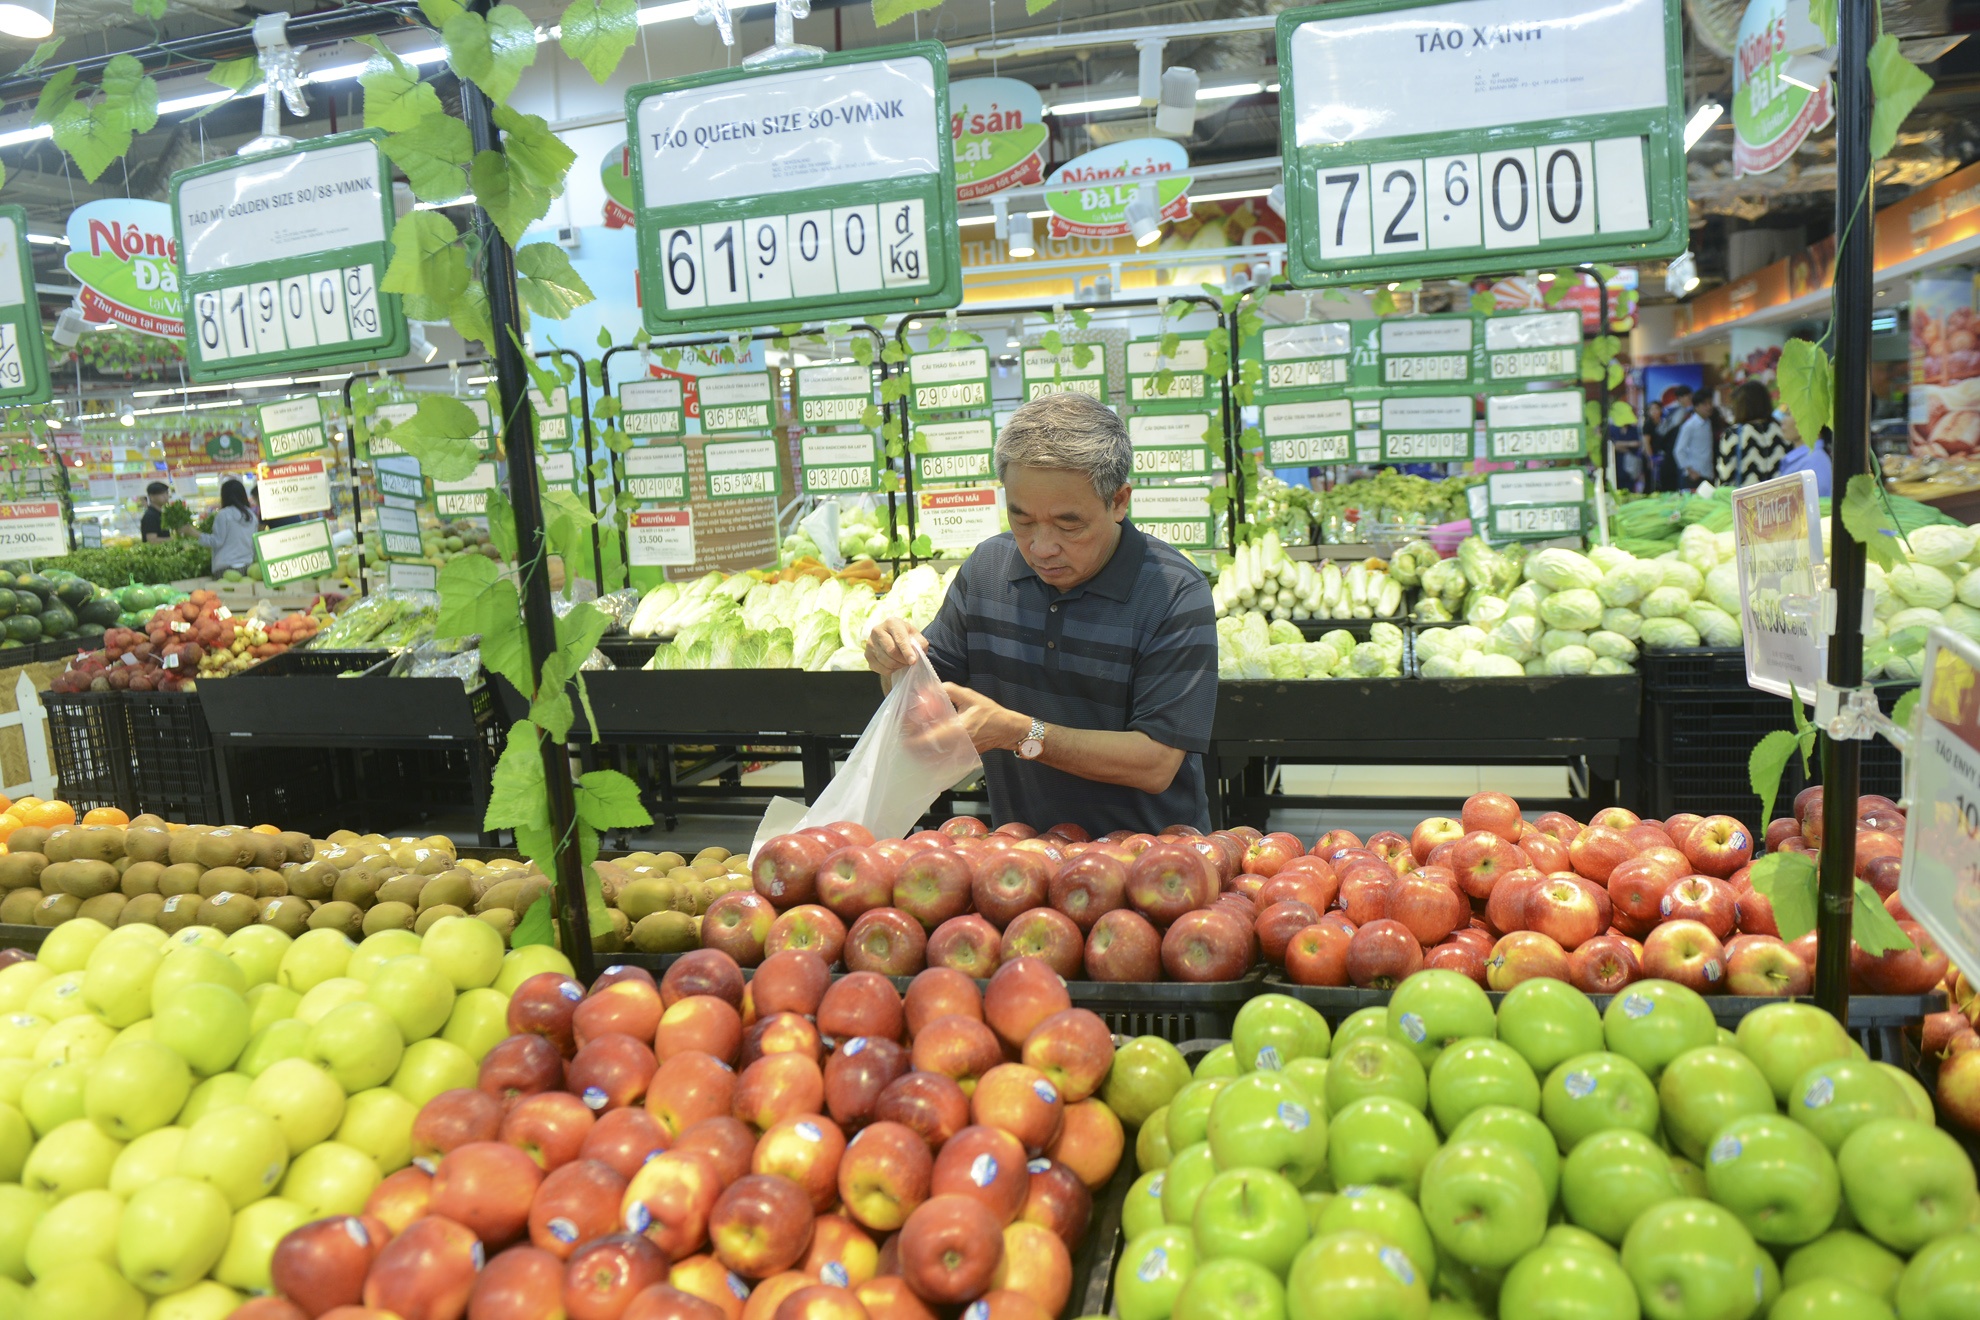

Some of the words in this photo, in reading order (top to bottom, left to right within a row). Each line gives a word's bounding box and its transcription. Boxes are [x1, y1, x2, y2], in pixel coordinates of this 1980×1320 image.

[1416, 28, 1463, 52] TÁO
[651, 127, 687, 151] TÁO
[694, 119, 756, 148] QUEEN
[762, 113, 801, 135] SIZE
[808, 100, 904, 129] 80-VMNK
[970, 103, 1022, 134] sản
[188, 208, 207, 226] TÁO
[228, 197, 270, 218] GOLDEN
[272, 192, 294, 208] SIZE
[1081, 187, 1112, 211] Đà
[93, 296, 113, 315] Thu
[114, 309, 138, 325] mua
[140, 317, 154, 330] tại
[11, 505, 46, 517] VinMart
[936, 495, 964, 505] KHUYẾN
[965, 493, 981, 503] MÃI
[641, 515, 664, 524] KHUYẾN
[933, 516, 963, 526] 11.500
[638, 535, 663, 545] 33.500
